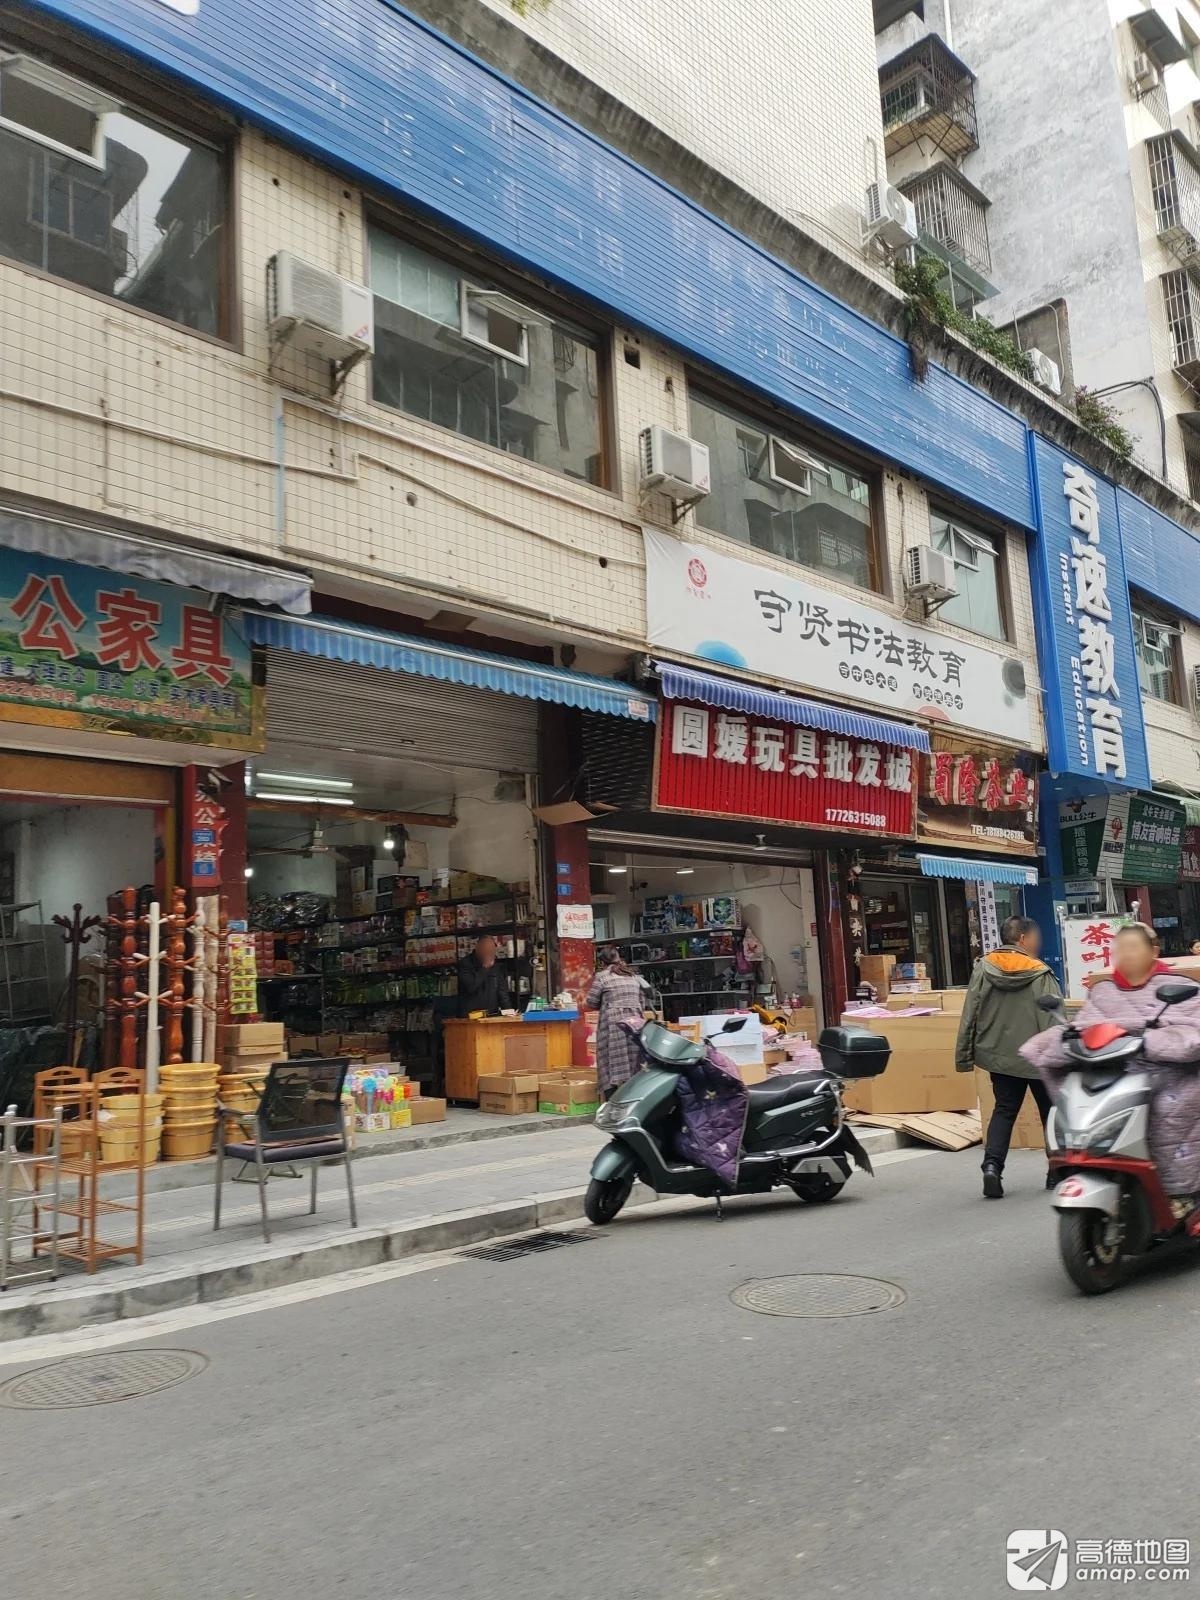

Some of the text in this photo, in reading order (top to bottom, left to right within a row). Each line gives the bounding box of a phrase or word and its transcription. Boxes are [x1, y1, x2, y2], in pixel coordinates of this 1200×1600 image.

[10, 573, 233, 688] 公家具
[754, 589, 966, 688] 守贤书法教育
[1059, 553, 1089, 766] Instant Education
[1062, 461, 1126, 779] 奇速教育
[672, 706, 912, 793] 圆媛玩具批发城
[825, 808, 886, 828] 17726315088
